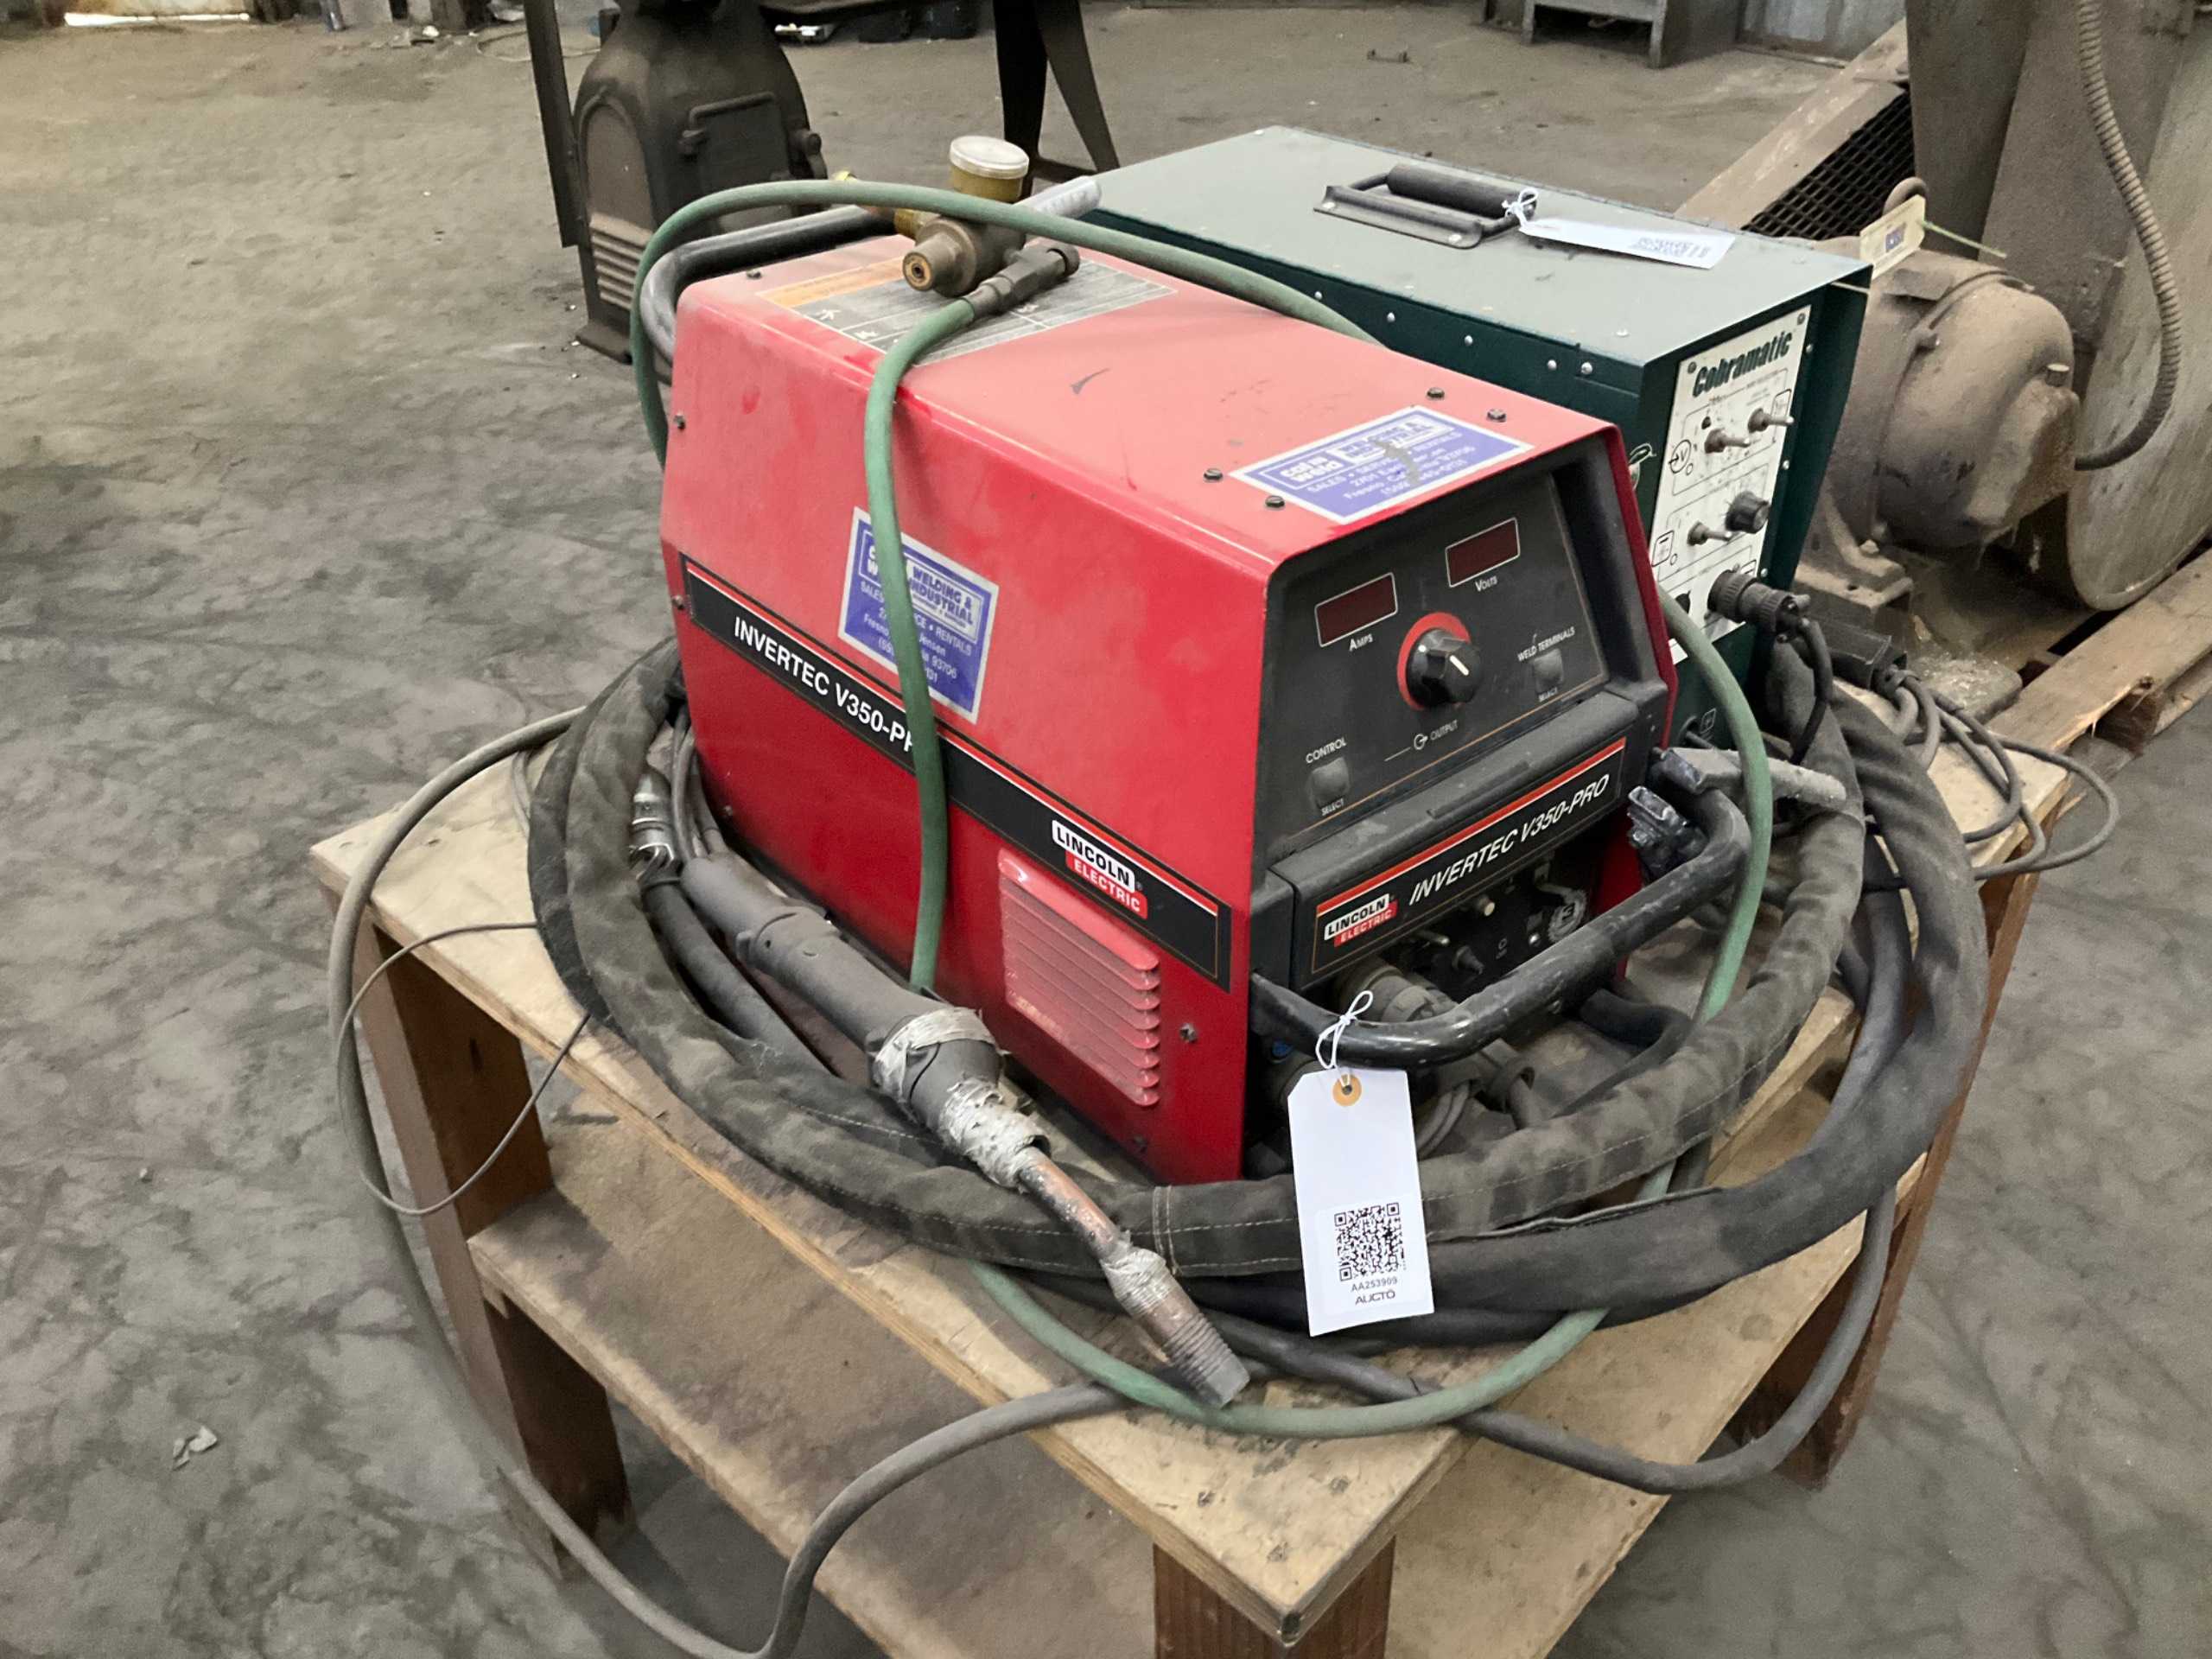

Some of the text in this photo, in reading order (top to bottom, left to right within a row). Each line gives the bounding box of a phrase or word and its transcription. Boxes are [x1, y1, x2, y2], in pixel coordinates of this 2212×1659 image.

[1692, 330, 1793, 398] Cobramatic
[912, 566, 972, 608] WELDING &
[734, 616, 830, 696] INVERTEC
[1517, 626, 1576, 662] WELD TERMINALS
[1430, 719, 1459, 741] OUTPUT
[1306, 737, 1348, 764] CONTROL
[1321, 798, 1344, 817] SELECT
[1057, 826, 1129, 887] LINCOLN
[1408, 774, 1611, 906] INVERTEC V350-PRO
[1074, 858, 1141, 912] ELECTRIC
[1326, 899, 1387, 938] LINCOLN
[1340, 913, 1394, 941] ELECTRIC
